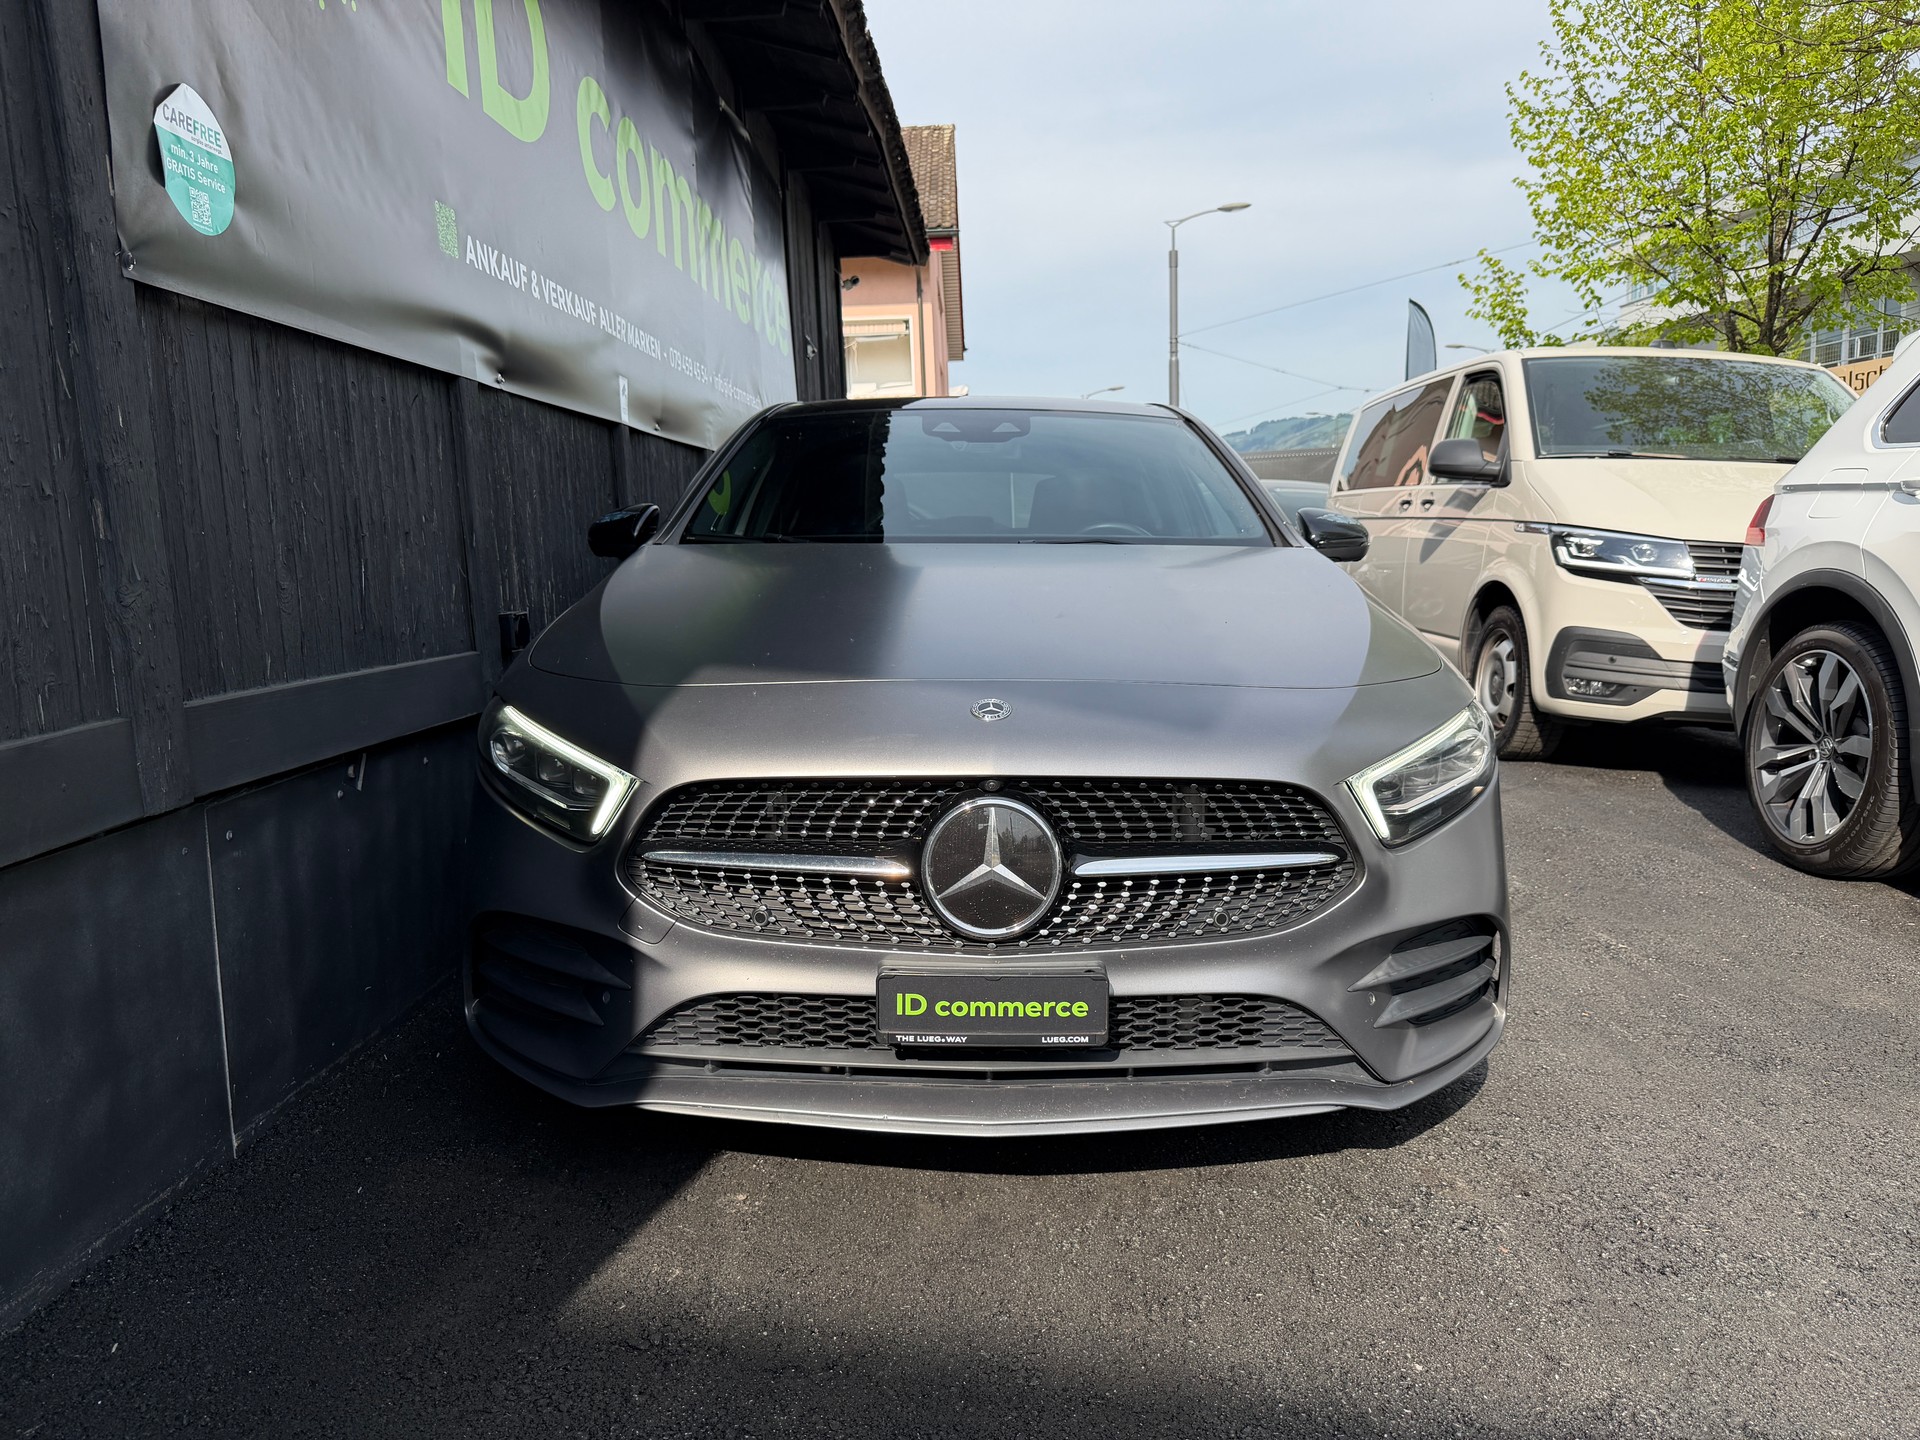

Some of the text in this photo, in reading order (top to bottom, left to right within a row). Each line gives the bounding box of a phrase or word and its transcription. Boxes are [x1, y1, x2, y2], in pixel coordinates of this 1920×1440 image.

[162, 103, 222, 149] CAREFREE
[166, 157, 226, 194] GRATIS Service
[170, 144, 218, 174] min. 3 Jahre
[577, 76, 789, 356] commerce
[465, 234, 528, 292] ANKAUF
[531, 276, 541, 300] &
[541, 277, 597, 326] VERKAUF
[599, 305, 628, 341] ALLER
[627, 322, 661, 361] MARKEN
[669, 347, 682, 372] 079
[896, 992, 1089, 1018] ID commerce
[895, 1034, 915, 1042] THE
